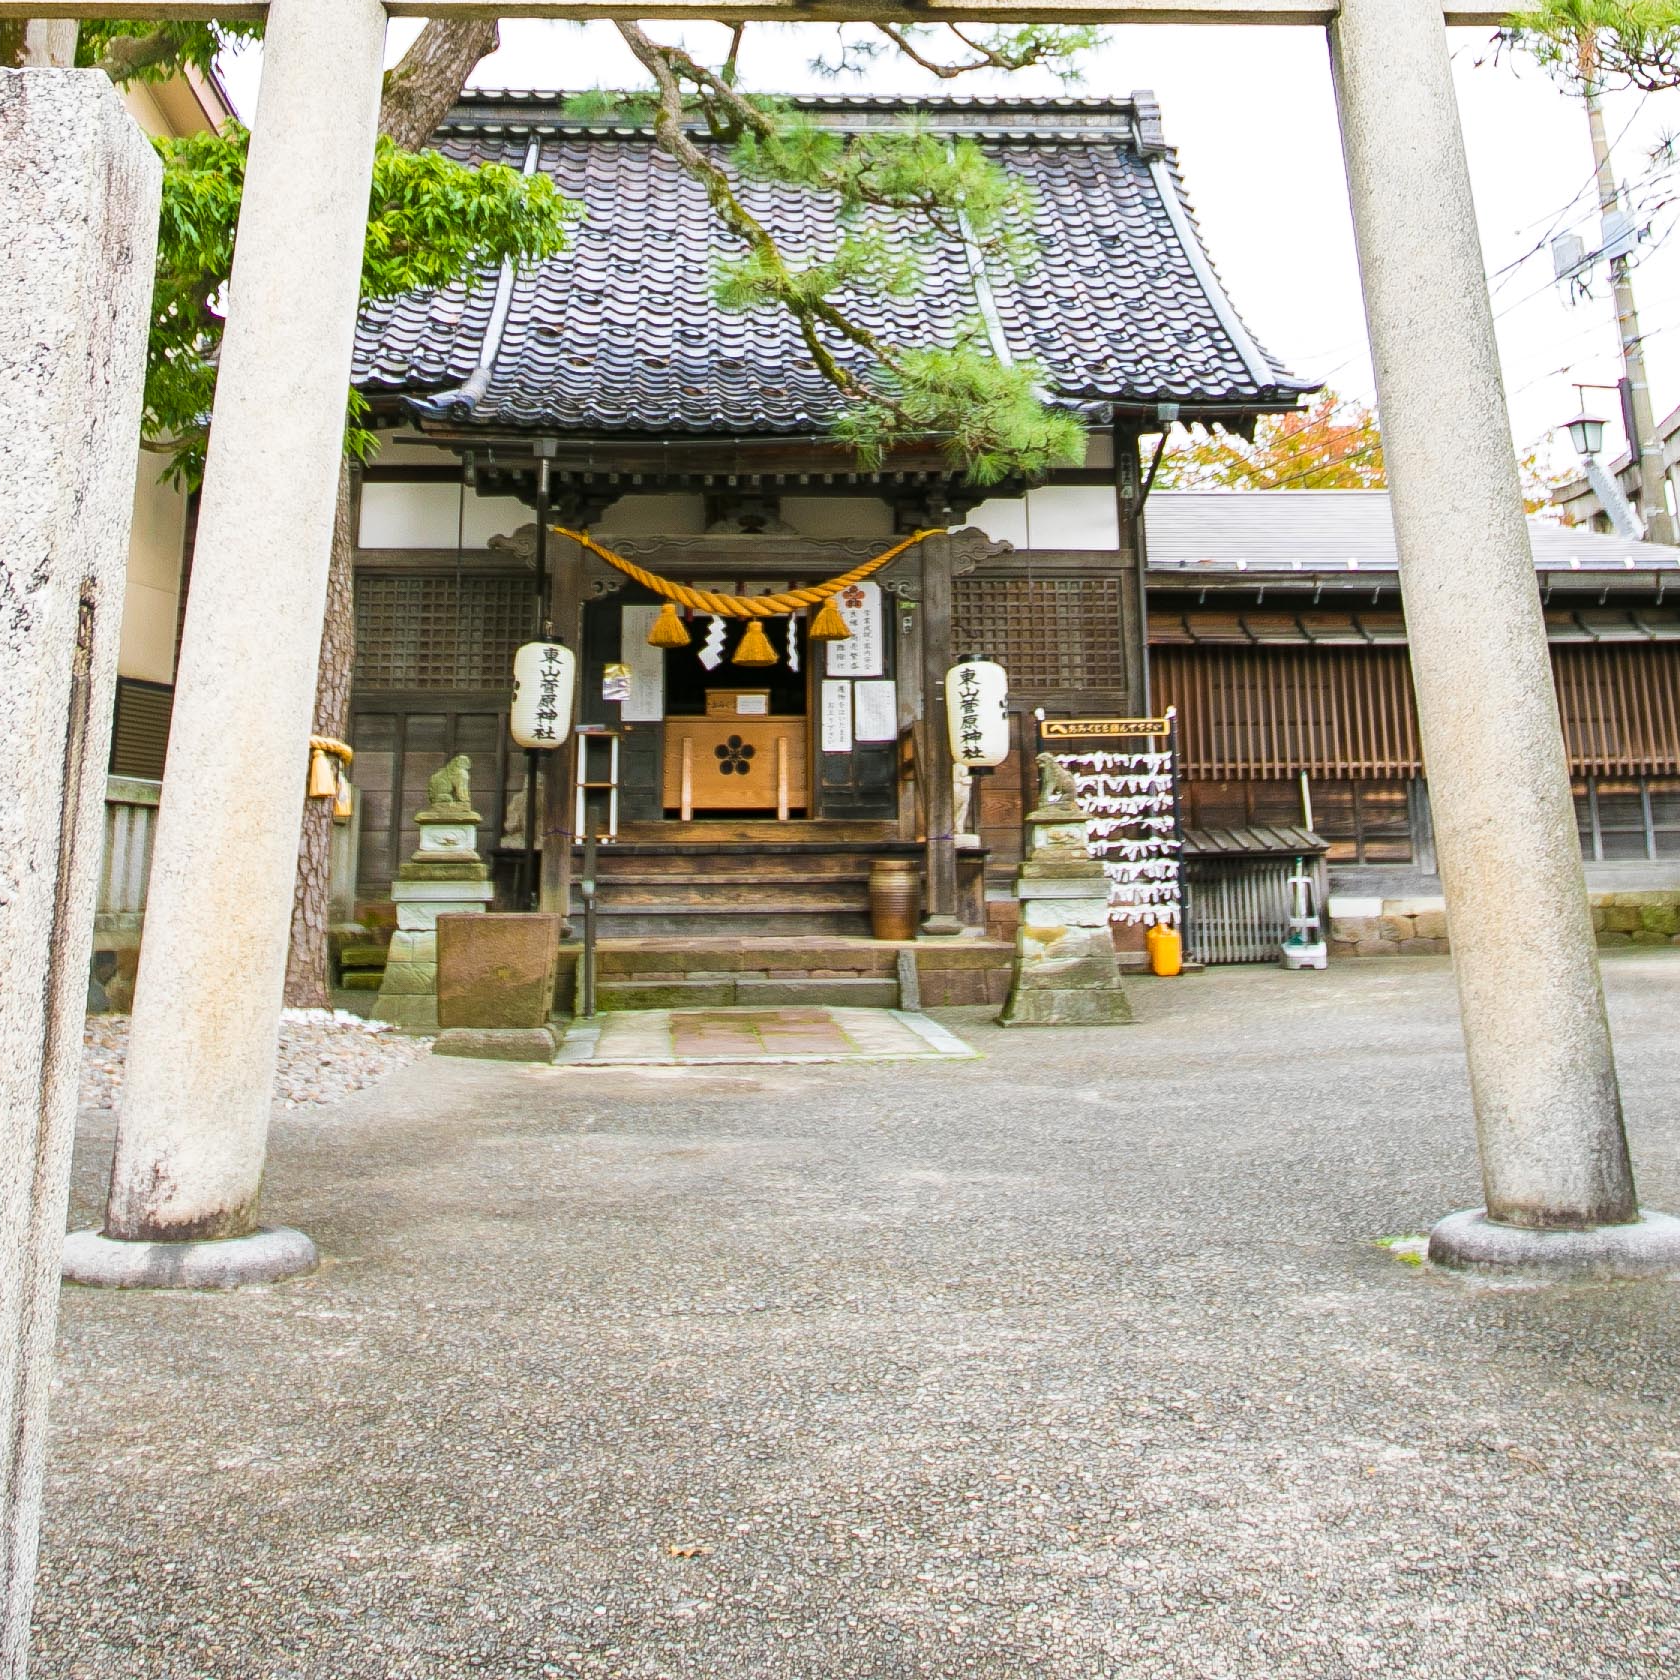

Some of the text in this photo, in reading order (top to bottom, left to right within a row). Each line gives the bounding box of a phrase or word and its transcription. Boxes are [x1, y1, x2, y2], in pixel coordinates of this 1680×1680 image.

[531, 647, 564, 740] 東山菅原神社
[958, 667, 985, 759] 東山菅原神社
